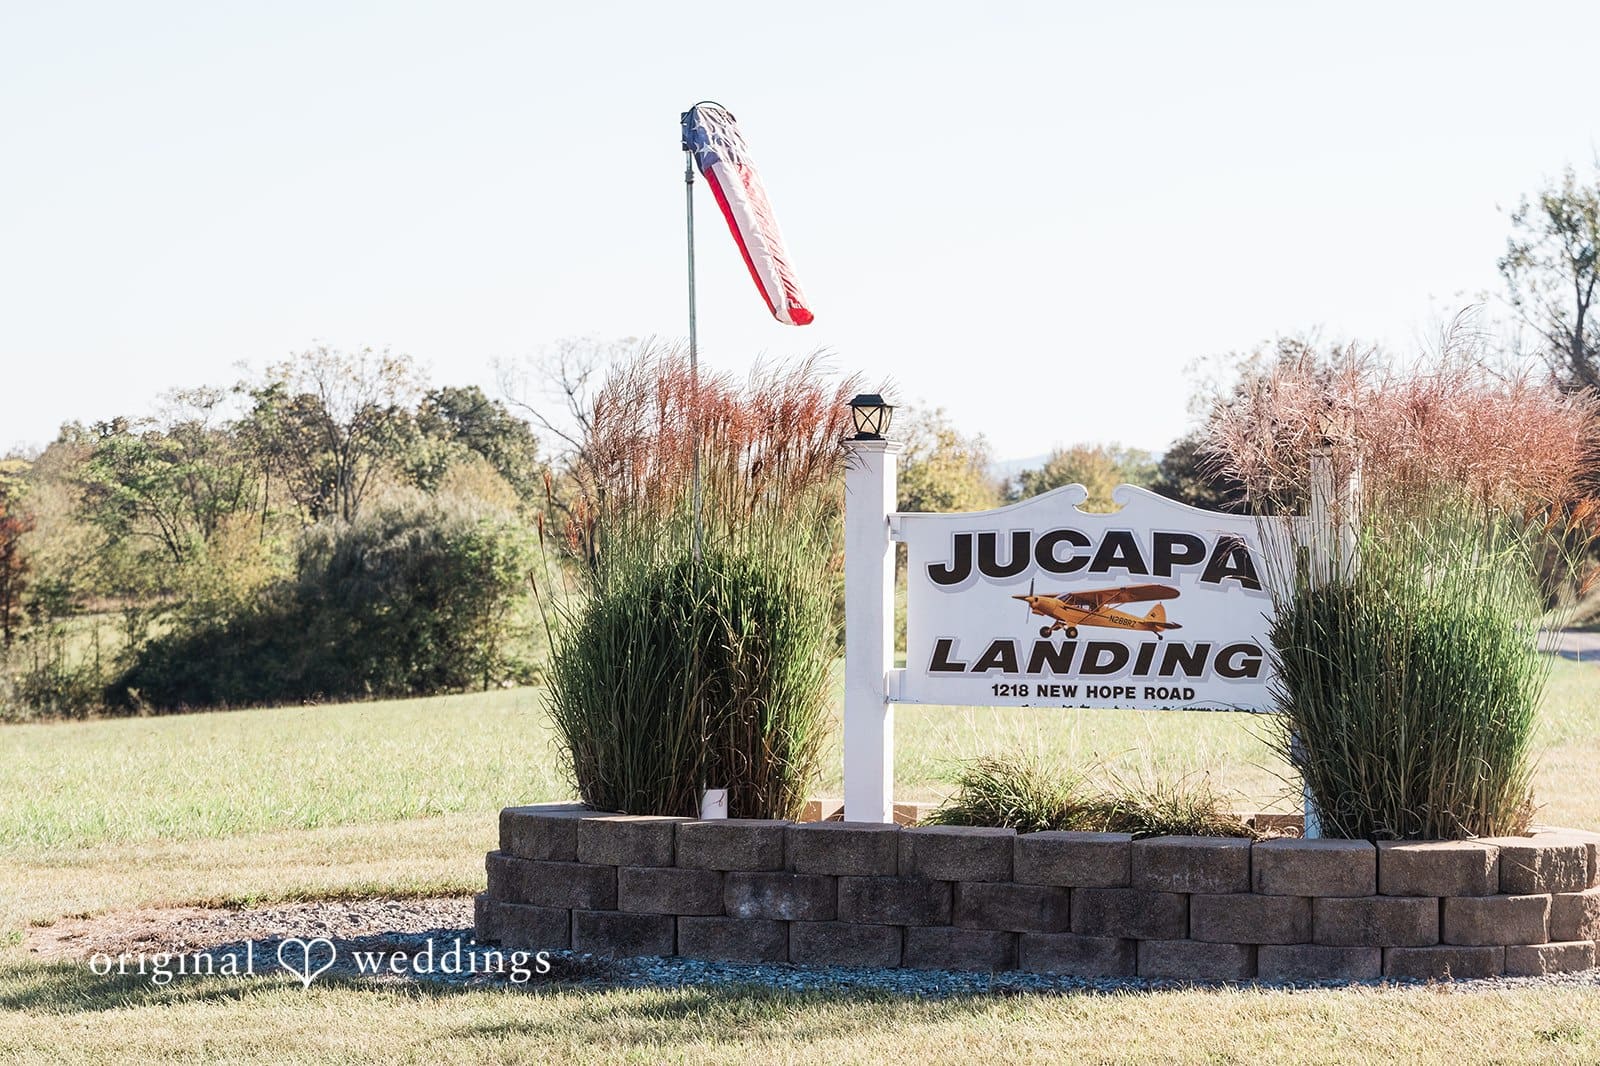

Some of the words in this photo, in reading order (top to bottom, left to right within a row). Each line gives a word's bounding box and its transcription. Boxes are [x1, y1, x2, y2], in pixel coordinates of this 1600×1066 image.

[927, 529, 1263, 592] JUCAPA
[928, 638, 1265, 679] LANDING
[991, 684, 1029, 698] 1218
[1036, 684, 1078, 698] NEW
[1086, 685, 1136, 699] HOPE
[1144, 686, 1195, 701] ROAD
